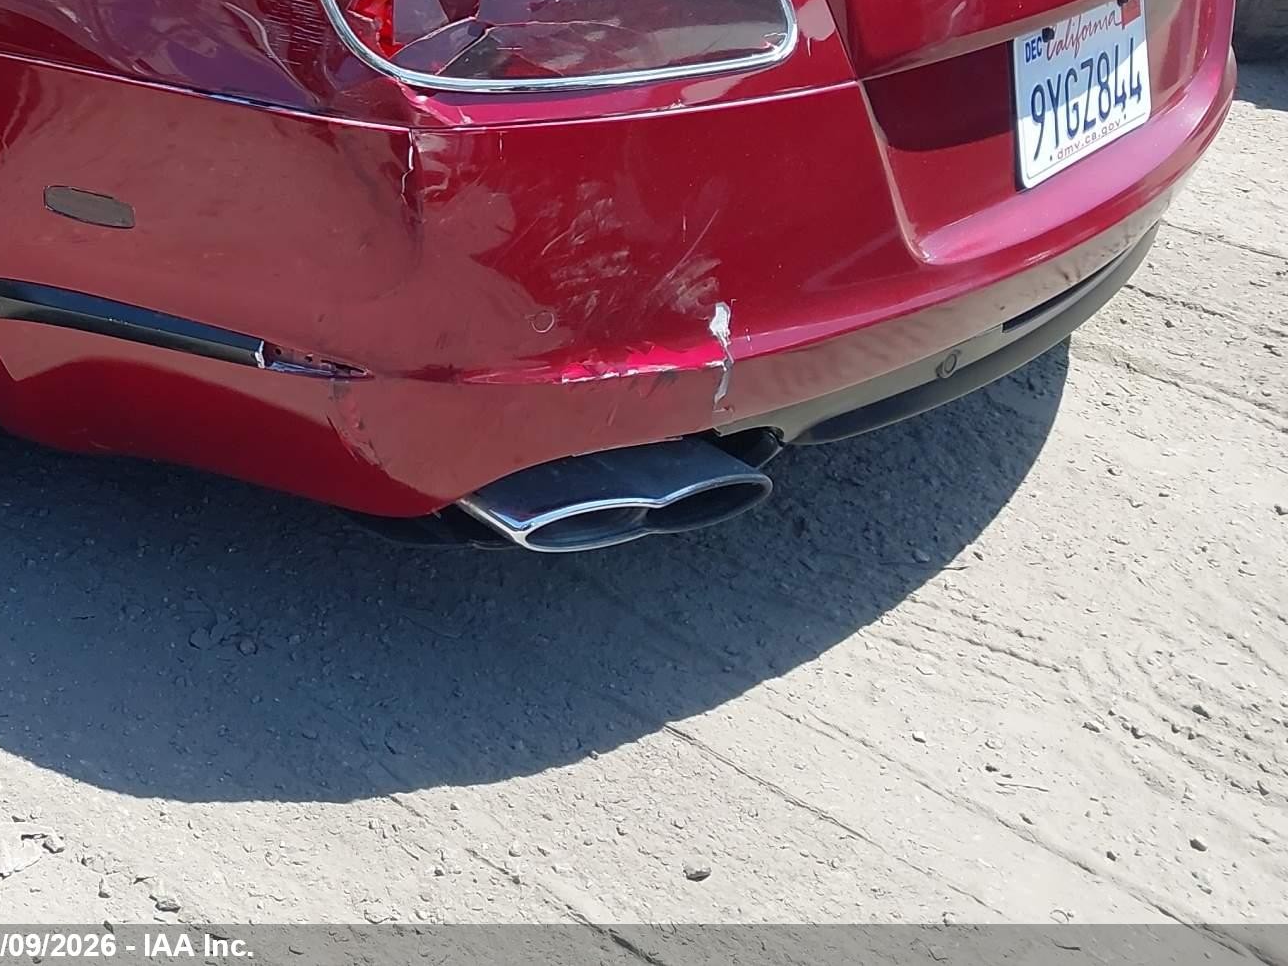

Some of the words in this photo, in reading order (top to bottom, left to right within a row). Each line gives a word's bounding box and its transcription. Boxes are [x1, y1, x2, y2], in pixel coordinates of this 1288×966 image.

[1025, 36, 1042, 63] DEC
[1045, 9, 1122, 61] California
[1031, 37, 1143, 162] 9YGZ844
[1057, 118, 1122, 161] dmv.ca.gov
